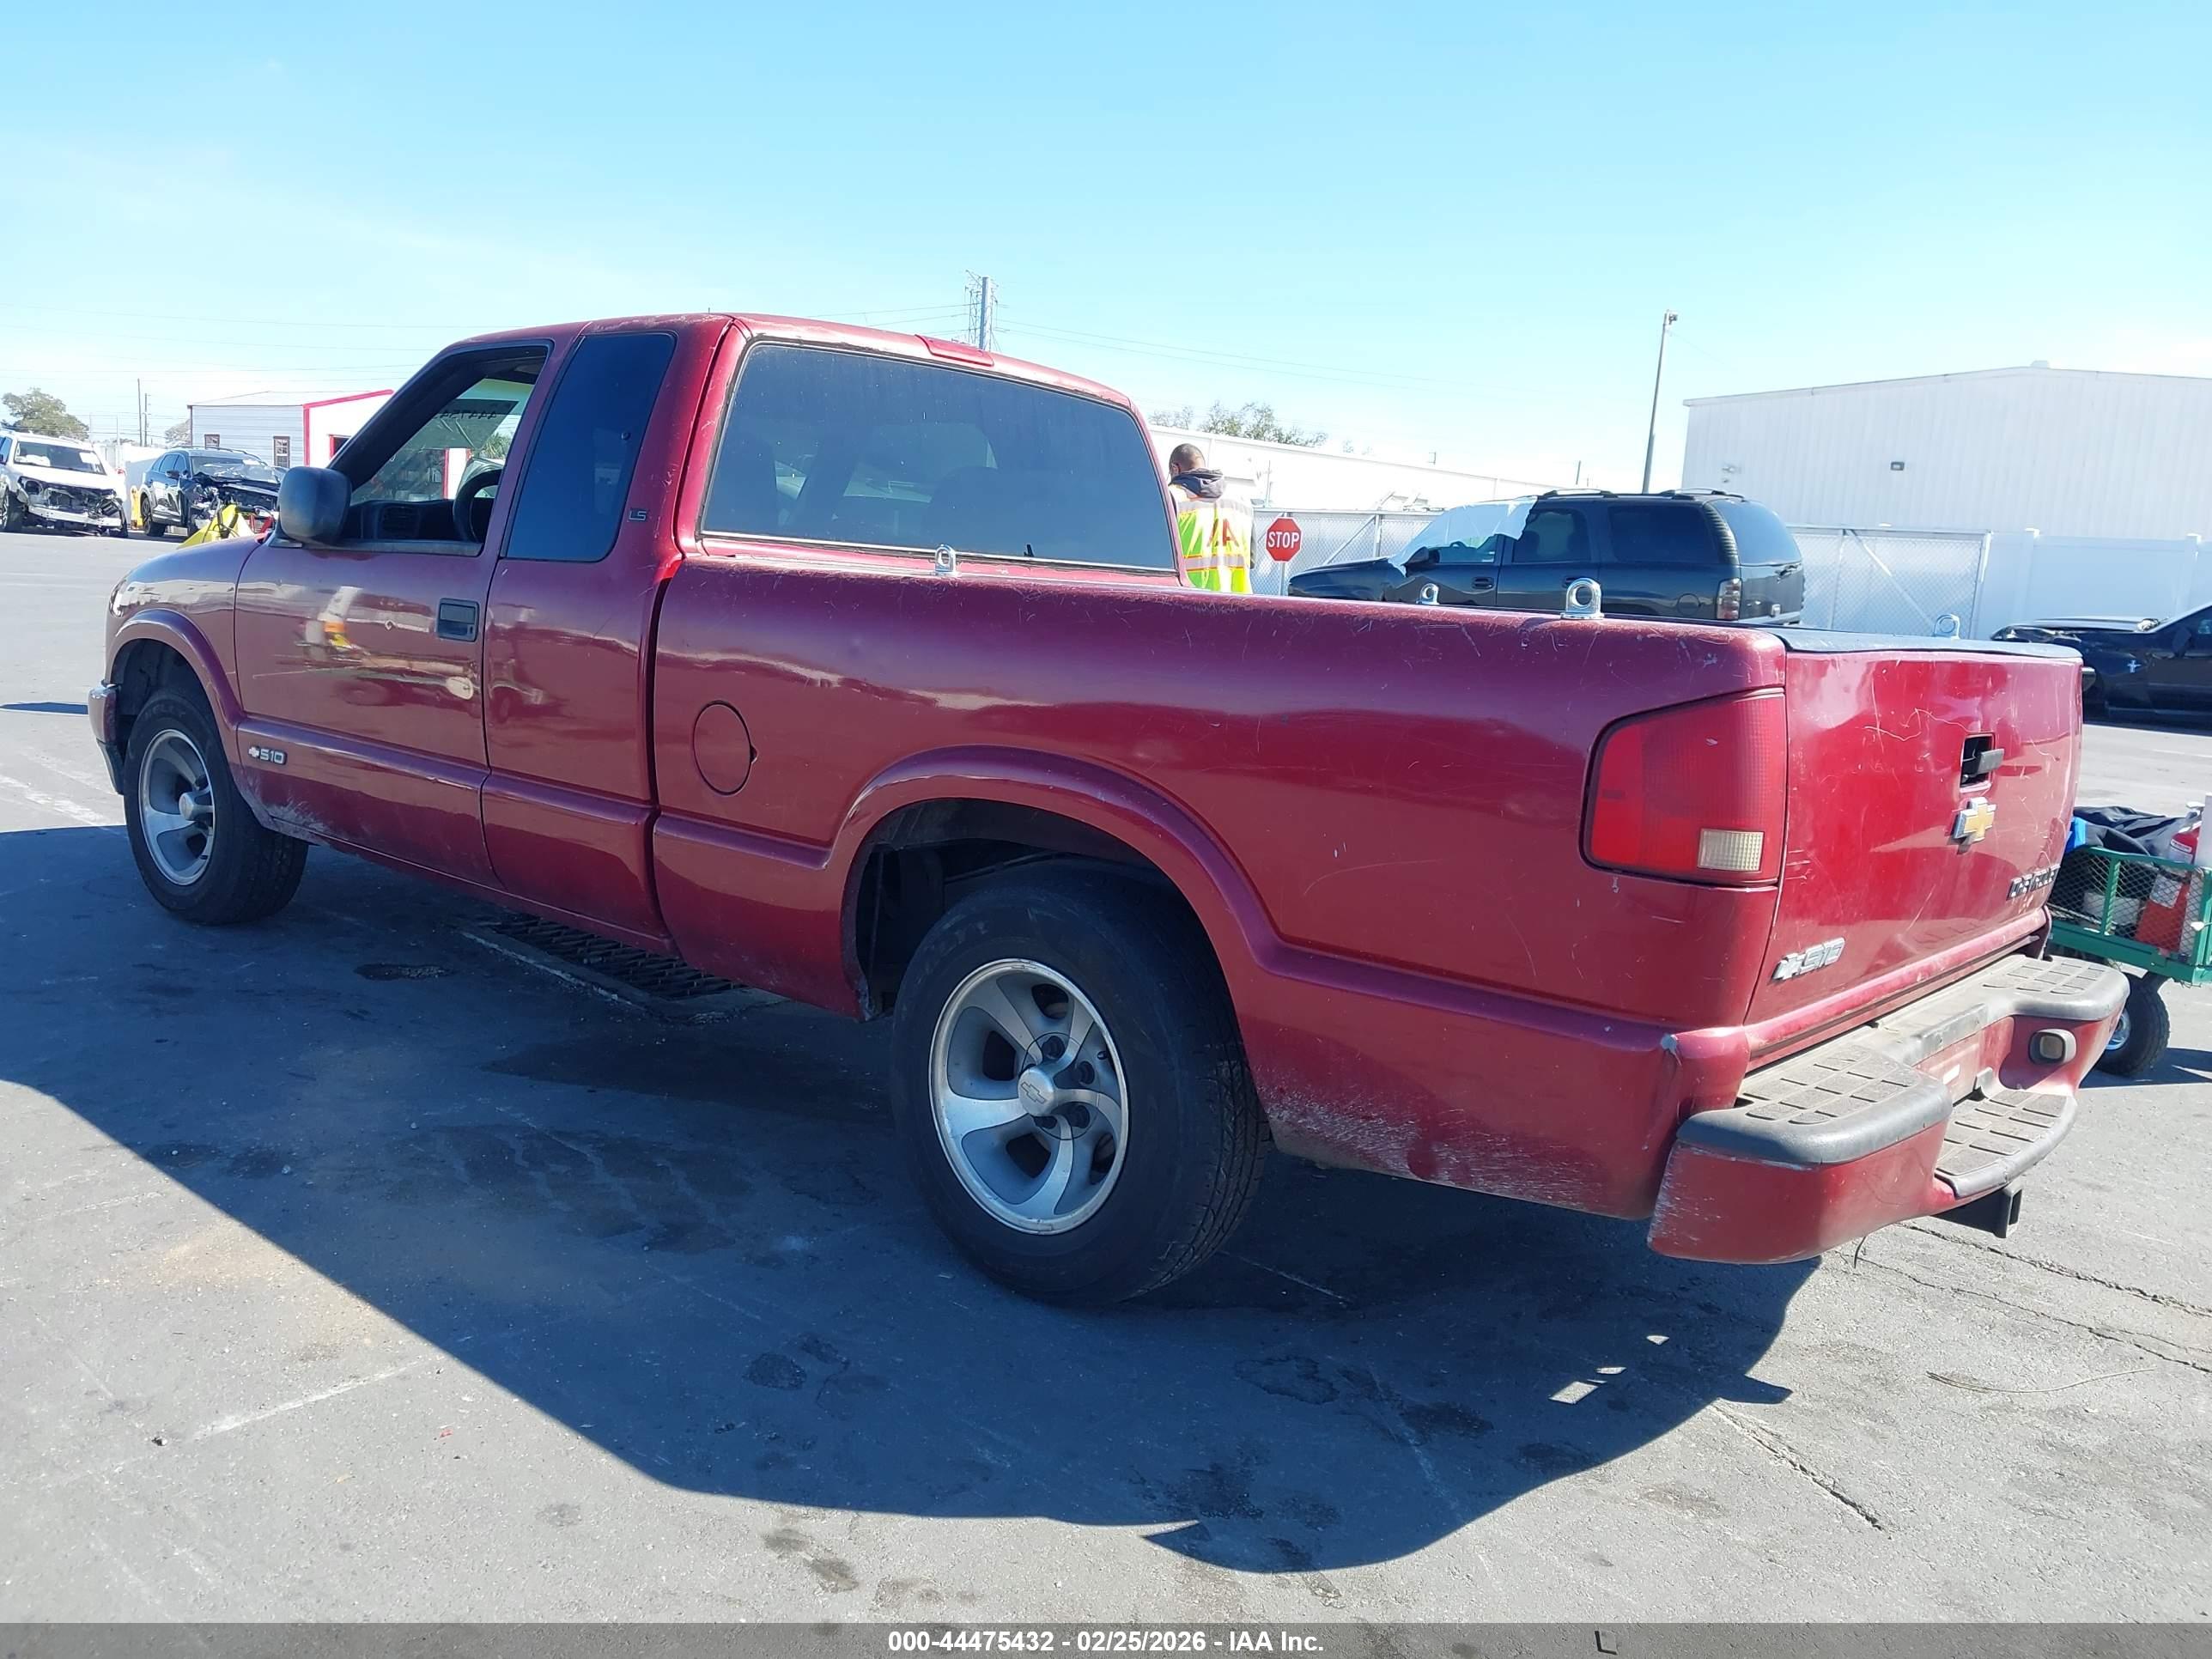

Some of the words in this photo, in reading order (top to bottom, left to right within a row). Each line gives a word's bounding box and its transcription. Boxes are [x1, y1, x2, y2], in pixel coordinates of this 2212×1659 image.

[629, 509, 647, 521] LS
[1267, 531, 1300, 549] STOP
[259, 747, 284, 764] S10
[1799, 937, 1845, 975] S10
